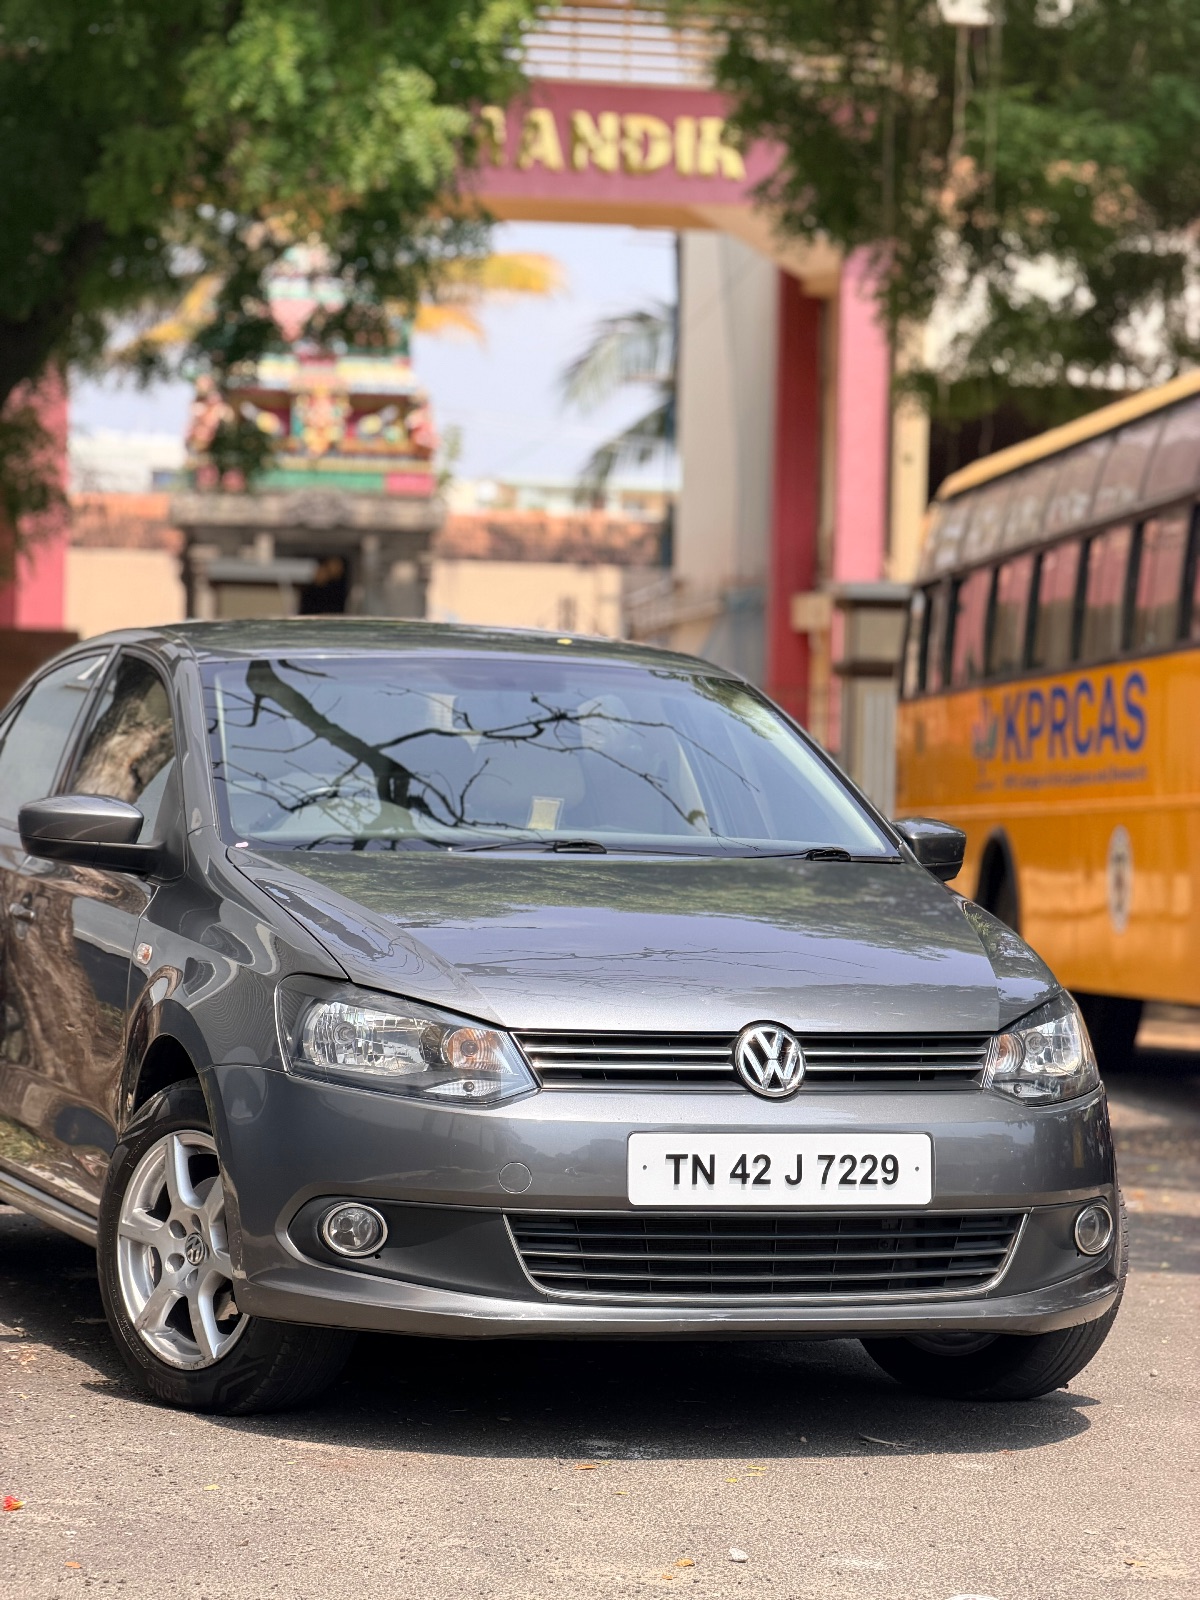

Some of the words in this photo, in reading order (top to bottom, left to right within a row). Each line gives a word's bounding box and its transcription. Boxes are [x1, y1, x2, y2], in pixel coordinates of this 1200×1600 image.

[1003, 671, 1147, 763] KPRCAS
[665, 1153, 716, 1186] TN
[729, 1153, 772, 1186] 42
[784, 1153, 803, 1186] J
[817, 1153, 900, 1187] 7229
